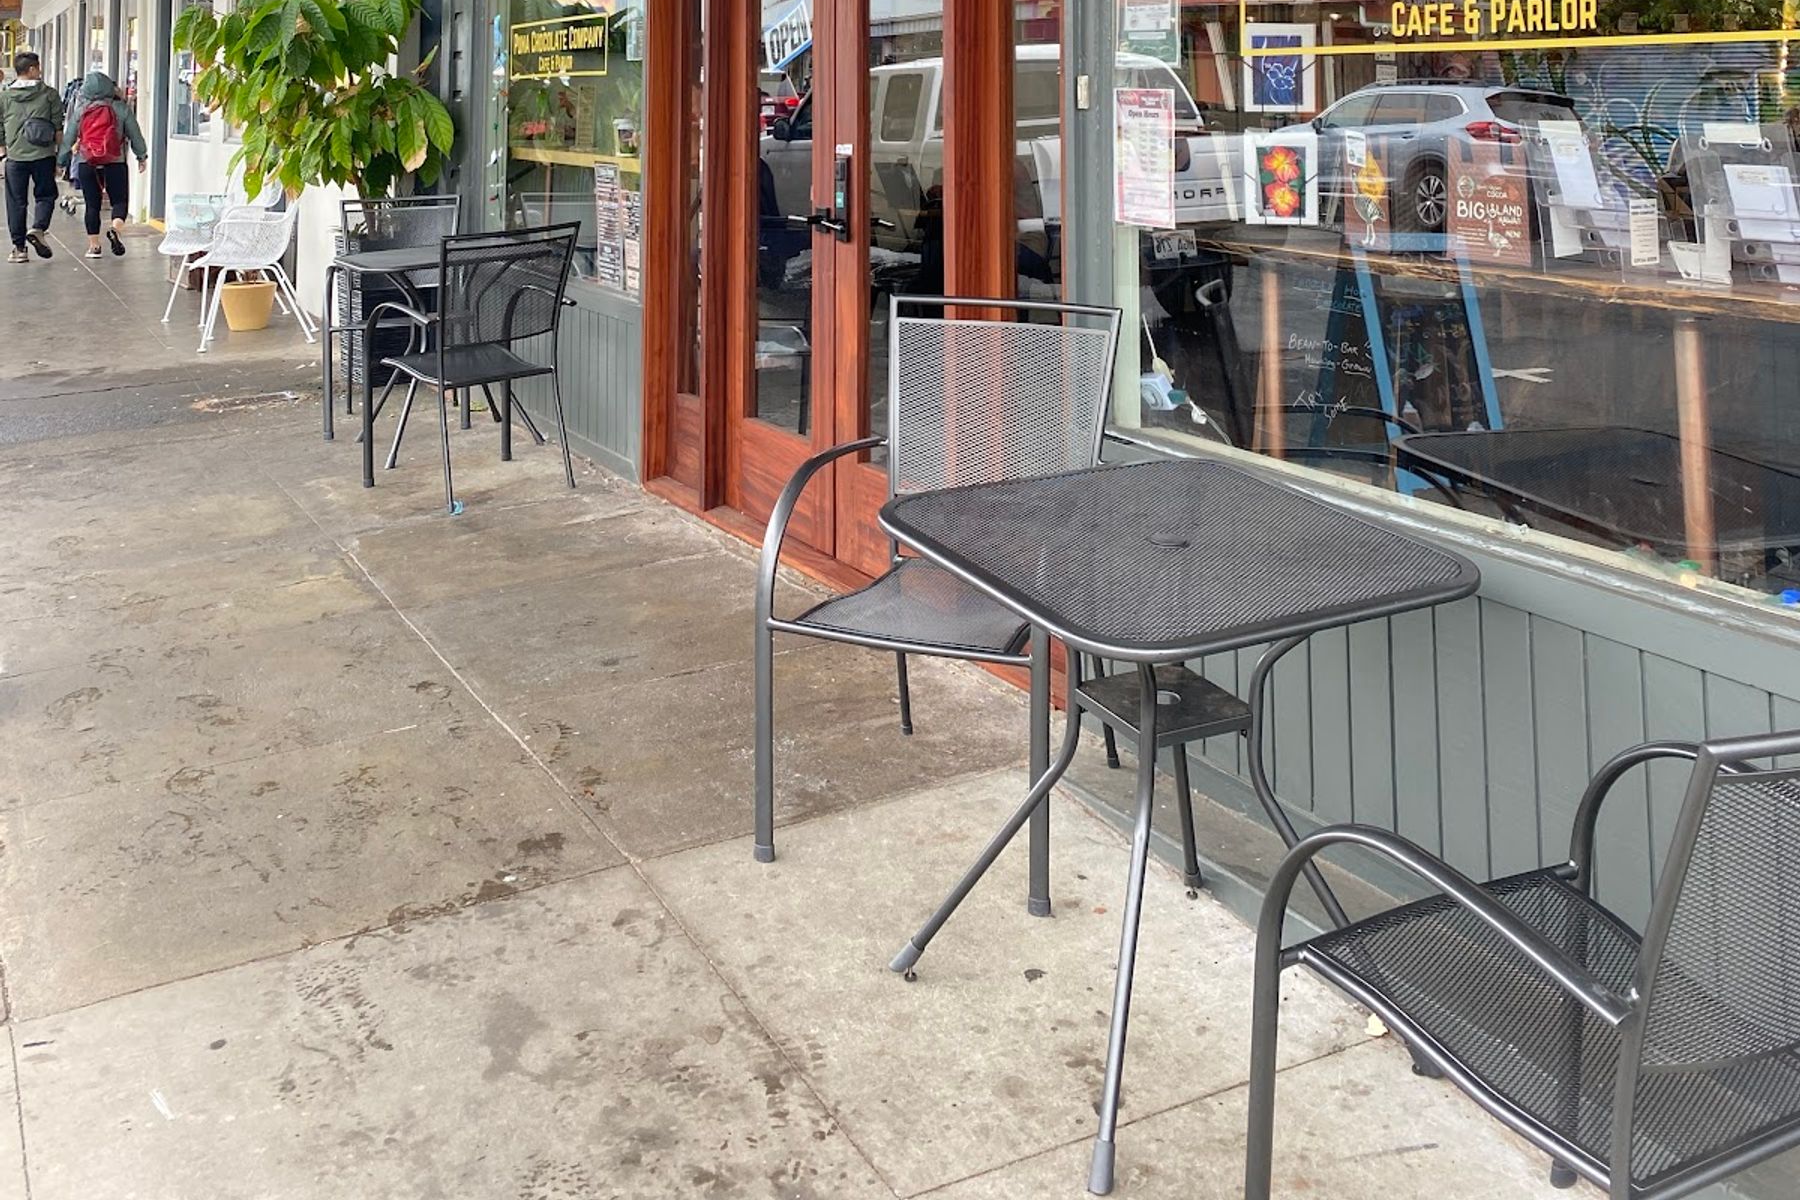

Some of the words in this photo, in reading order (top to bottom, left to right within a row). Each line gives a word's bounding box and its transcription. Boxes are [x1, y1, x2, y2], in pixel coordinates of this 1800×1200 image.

[1391, 1, 1455, 37] CAFE
[531, 29, 568, 54] CHOCOLATE
[568, 25, 604, 50] COMPANY
[769, 6, 809, 66] OPEN
[1128, 109, 1142, 119] Open
[1457, 200, 1485, 219] BIG
